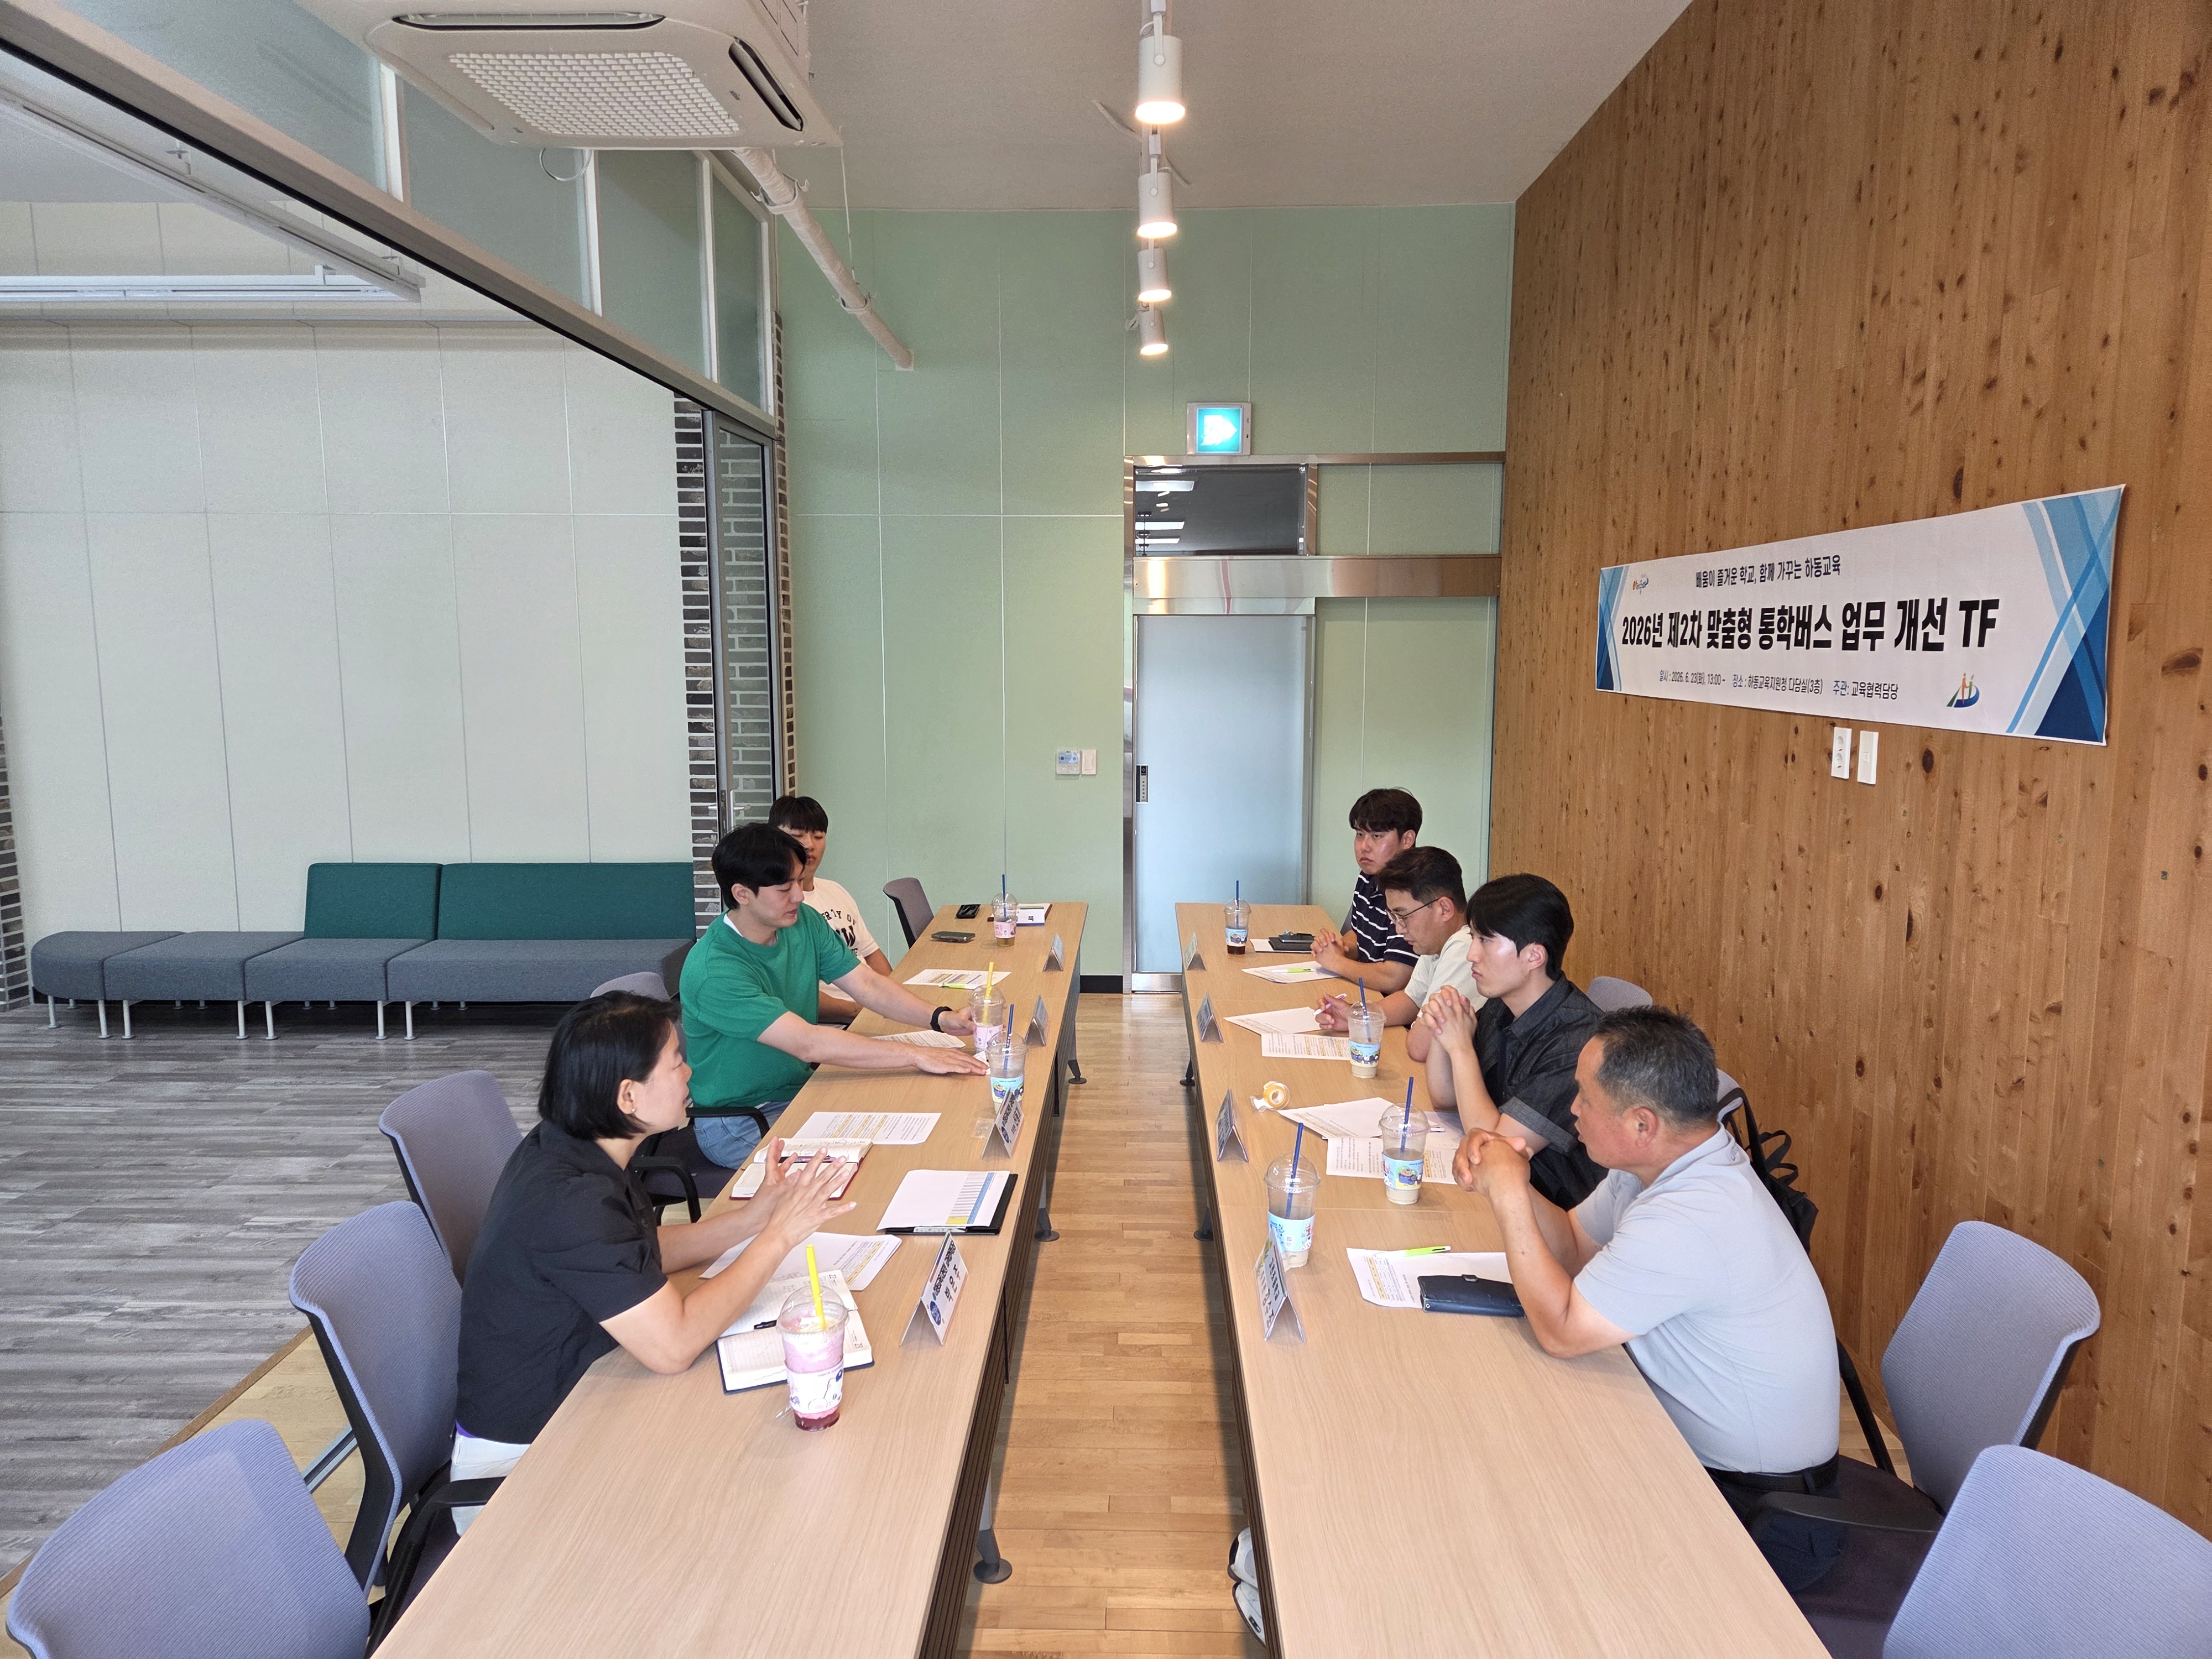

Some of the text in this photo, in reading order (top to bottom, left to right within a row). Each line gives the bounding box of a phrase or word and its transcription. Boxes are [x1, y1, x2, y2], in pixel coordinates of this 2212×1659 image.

[1695, 554, 1841, 588] 배움이 즐거운 학교, 함께 가꾸는 하동교육
[1621, 597, 2000, 651] 2026년 제2차 맞춤형 통학버스 업무 개선 TF
[1748, 675, 1787, 691] 하동교육지원청
[1788, 677, 1823, 695] 다담실(3층)
[1851, 681, 1899, 700] 교육협력담당
